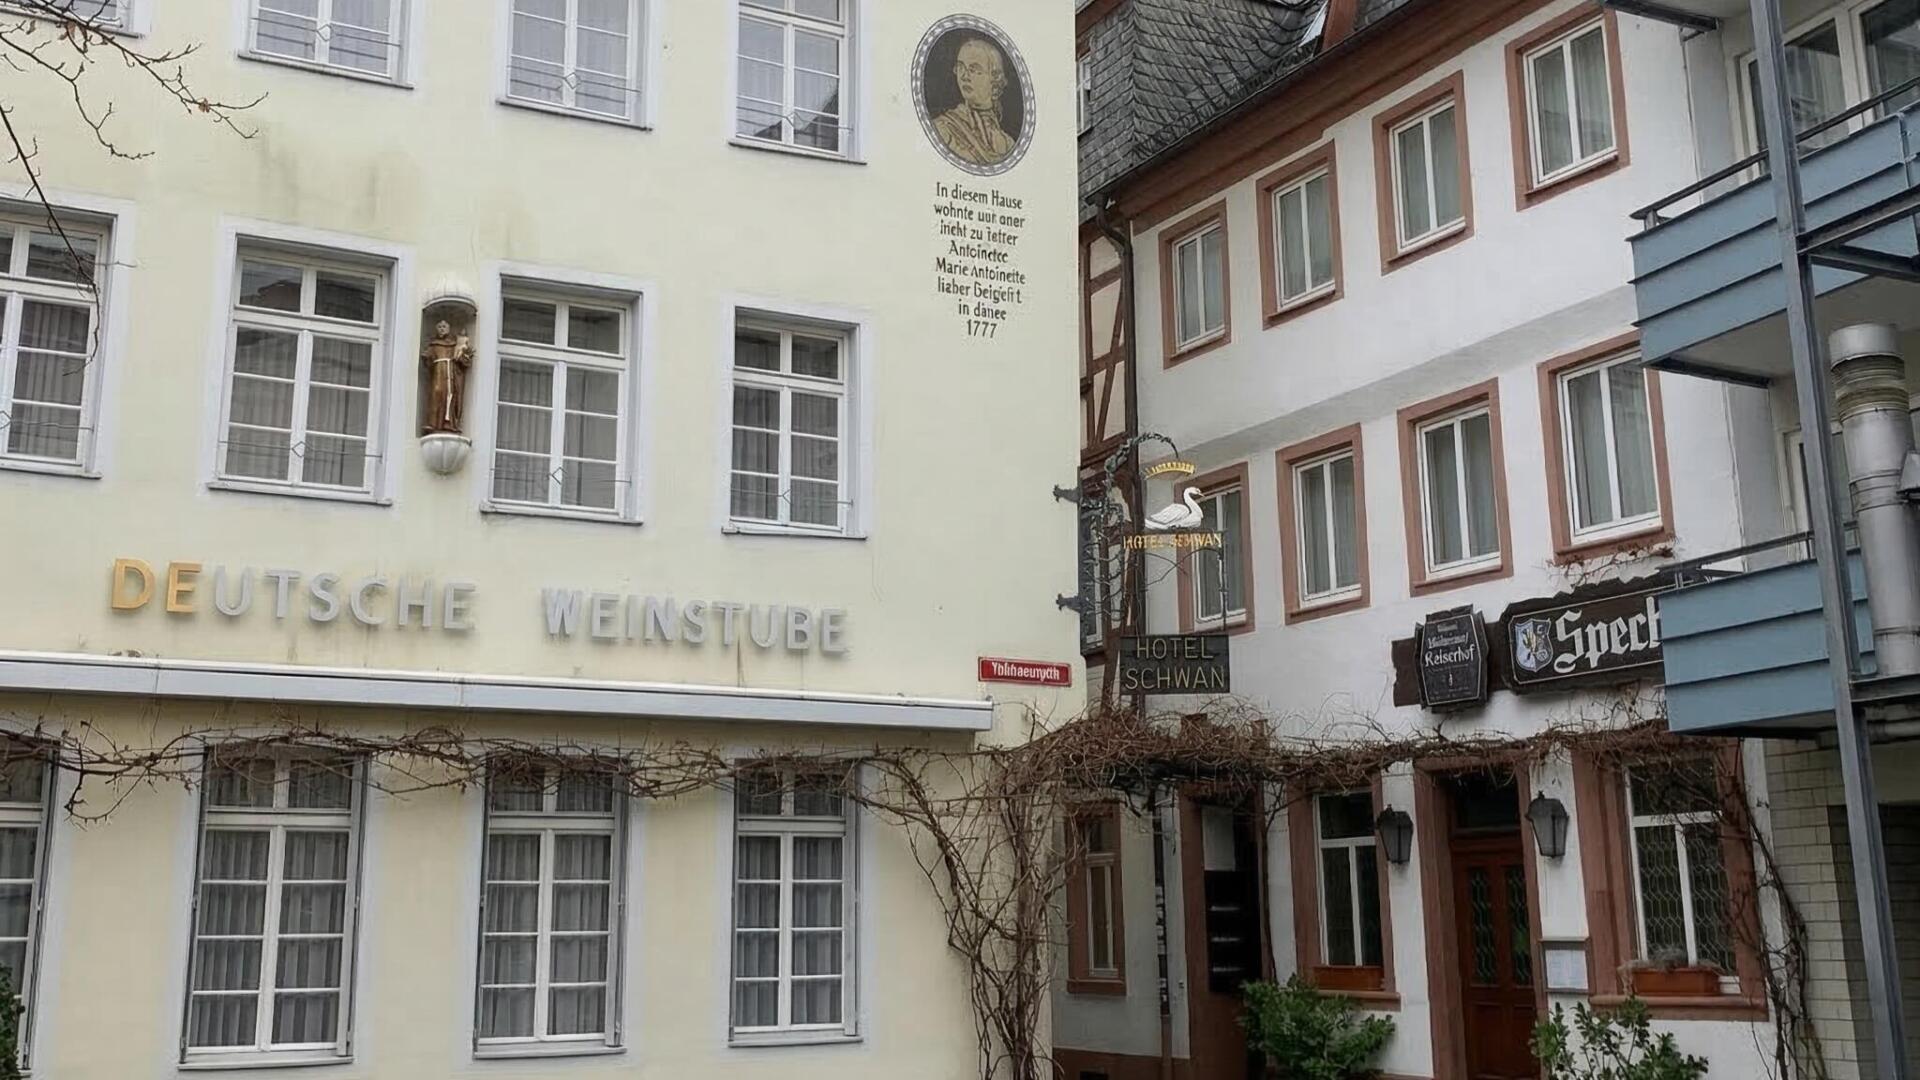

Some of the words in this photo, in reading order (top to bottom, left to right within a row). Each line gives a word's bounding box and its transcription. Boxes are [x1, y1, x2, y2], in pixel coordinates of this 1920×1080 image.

[936, 181, 948, 198] In
[951, 183, 988, 205] diesem
[991, 189, 1023, 210] Hause
[933, 201, 974, 221] wohnte
[935, 256, 969, 276] Marie
[958, 298, 970, 316] in
[966, 318, 998, 339] 1777
[112, 558, 476, 630] DEUTSCHE
[542, 588, 849, 653] WEINSTUBE
[1136, 636, 1214, 660] HOTEL
[1125, 666, 1224, 690] SCHWAN
